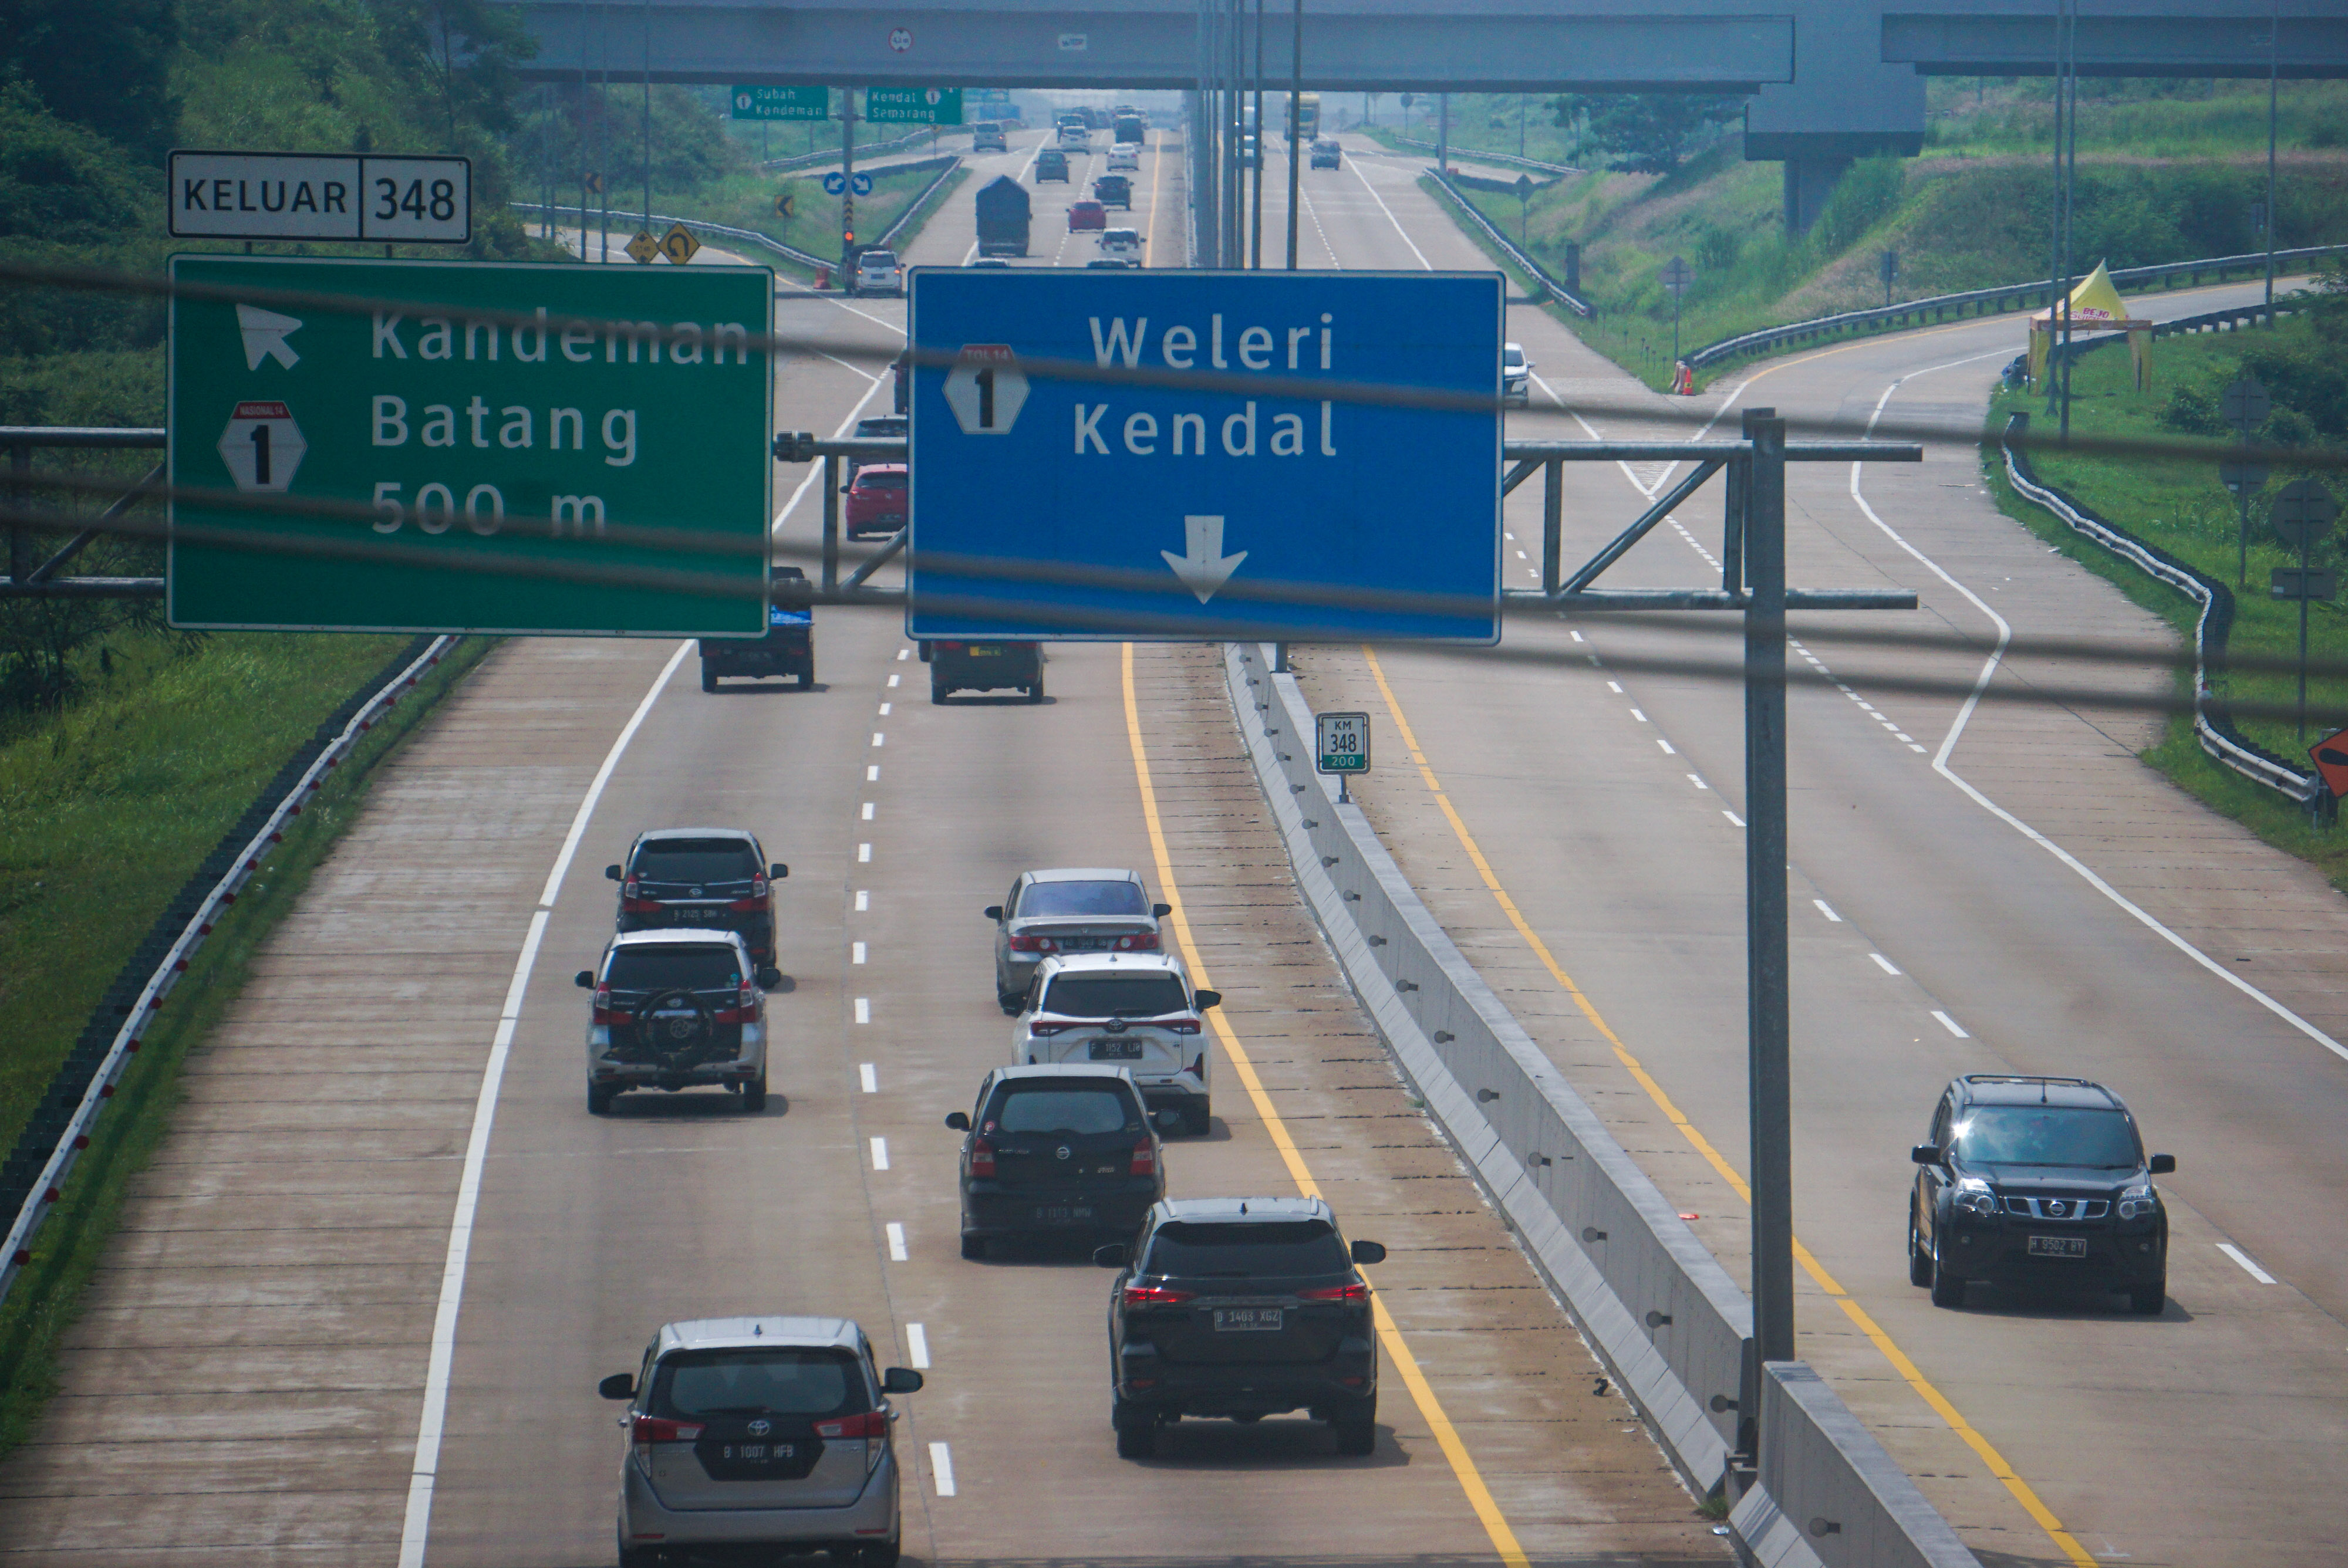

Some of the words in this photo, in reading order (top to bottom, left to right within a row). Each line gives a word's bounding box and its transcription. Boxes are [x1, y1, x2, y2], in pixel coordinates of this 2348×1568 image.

[757, 89, 796, 99] Subah
[872, 92, 916, 103] Kendal
[756, 104, 822, 116] Kandeman
[873, 107, 935, 122] Semarang
[184, 178, 346, 214] KELUAR
[375, 177, 455, 221] 348
[2083, 307, 2110, 319] BEJO
[372, 305, 747, 364] Kandeman
[1089, 312, 1334, 369] Weleri
[975, 368, 994, 427] 1
[239, 405, 274, 415] NASIONAL
[372, 394, 637, 467] Batang
[1074, 401, 1337, 457] Kendal
[250, 425, 270, 484] 1
[372, 482, 504, 536] 500
[551, 494, 606, 536] m
[1335, 721, 1351, 730] KM
[1330, 734, 1357, 752] 348
[1332, 756, 1355, 766] 200
[1106, 1043, 1121, 1053] 1152
[2042, 1239, 2066, 1251] 9502
[1229, 1311, 1253, 1322] 1403
[1260, 1310, 1278, 1322] XGZ
[724, 1446, 730, 1458] B
[740, 1445, 765, 1458] 1007
[774, 1444, 794, 1458] HFB
